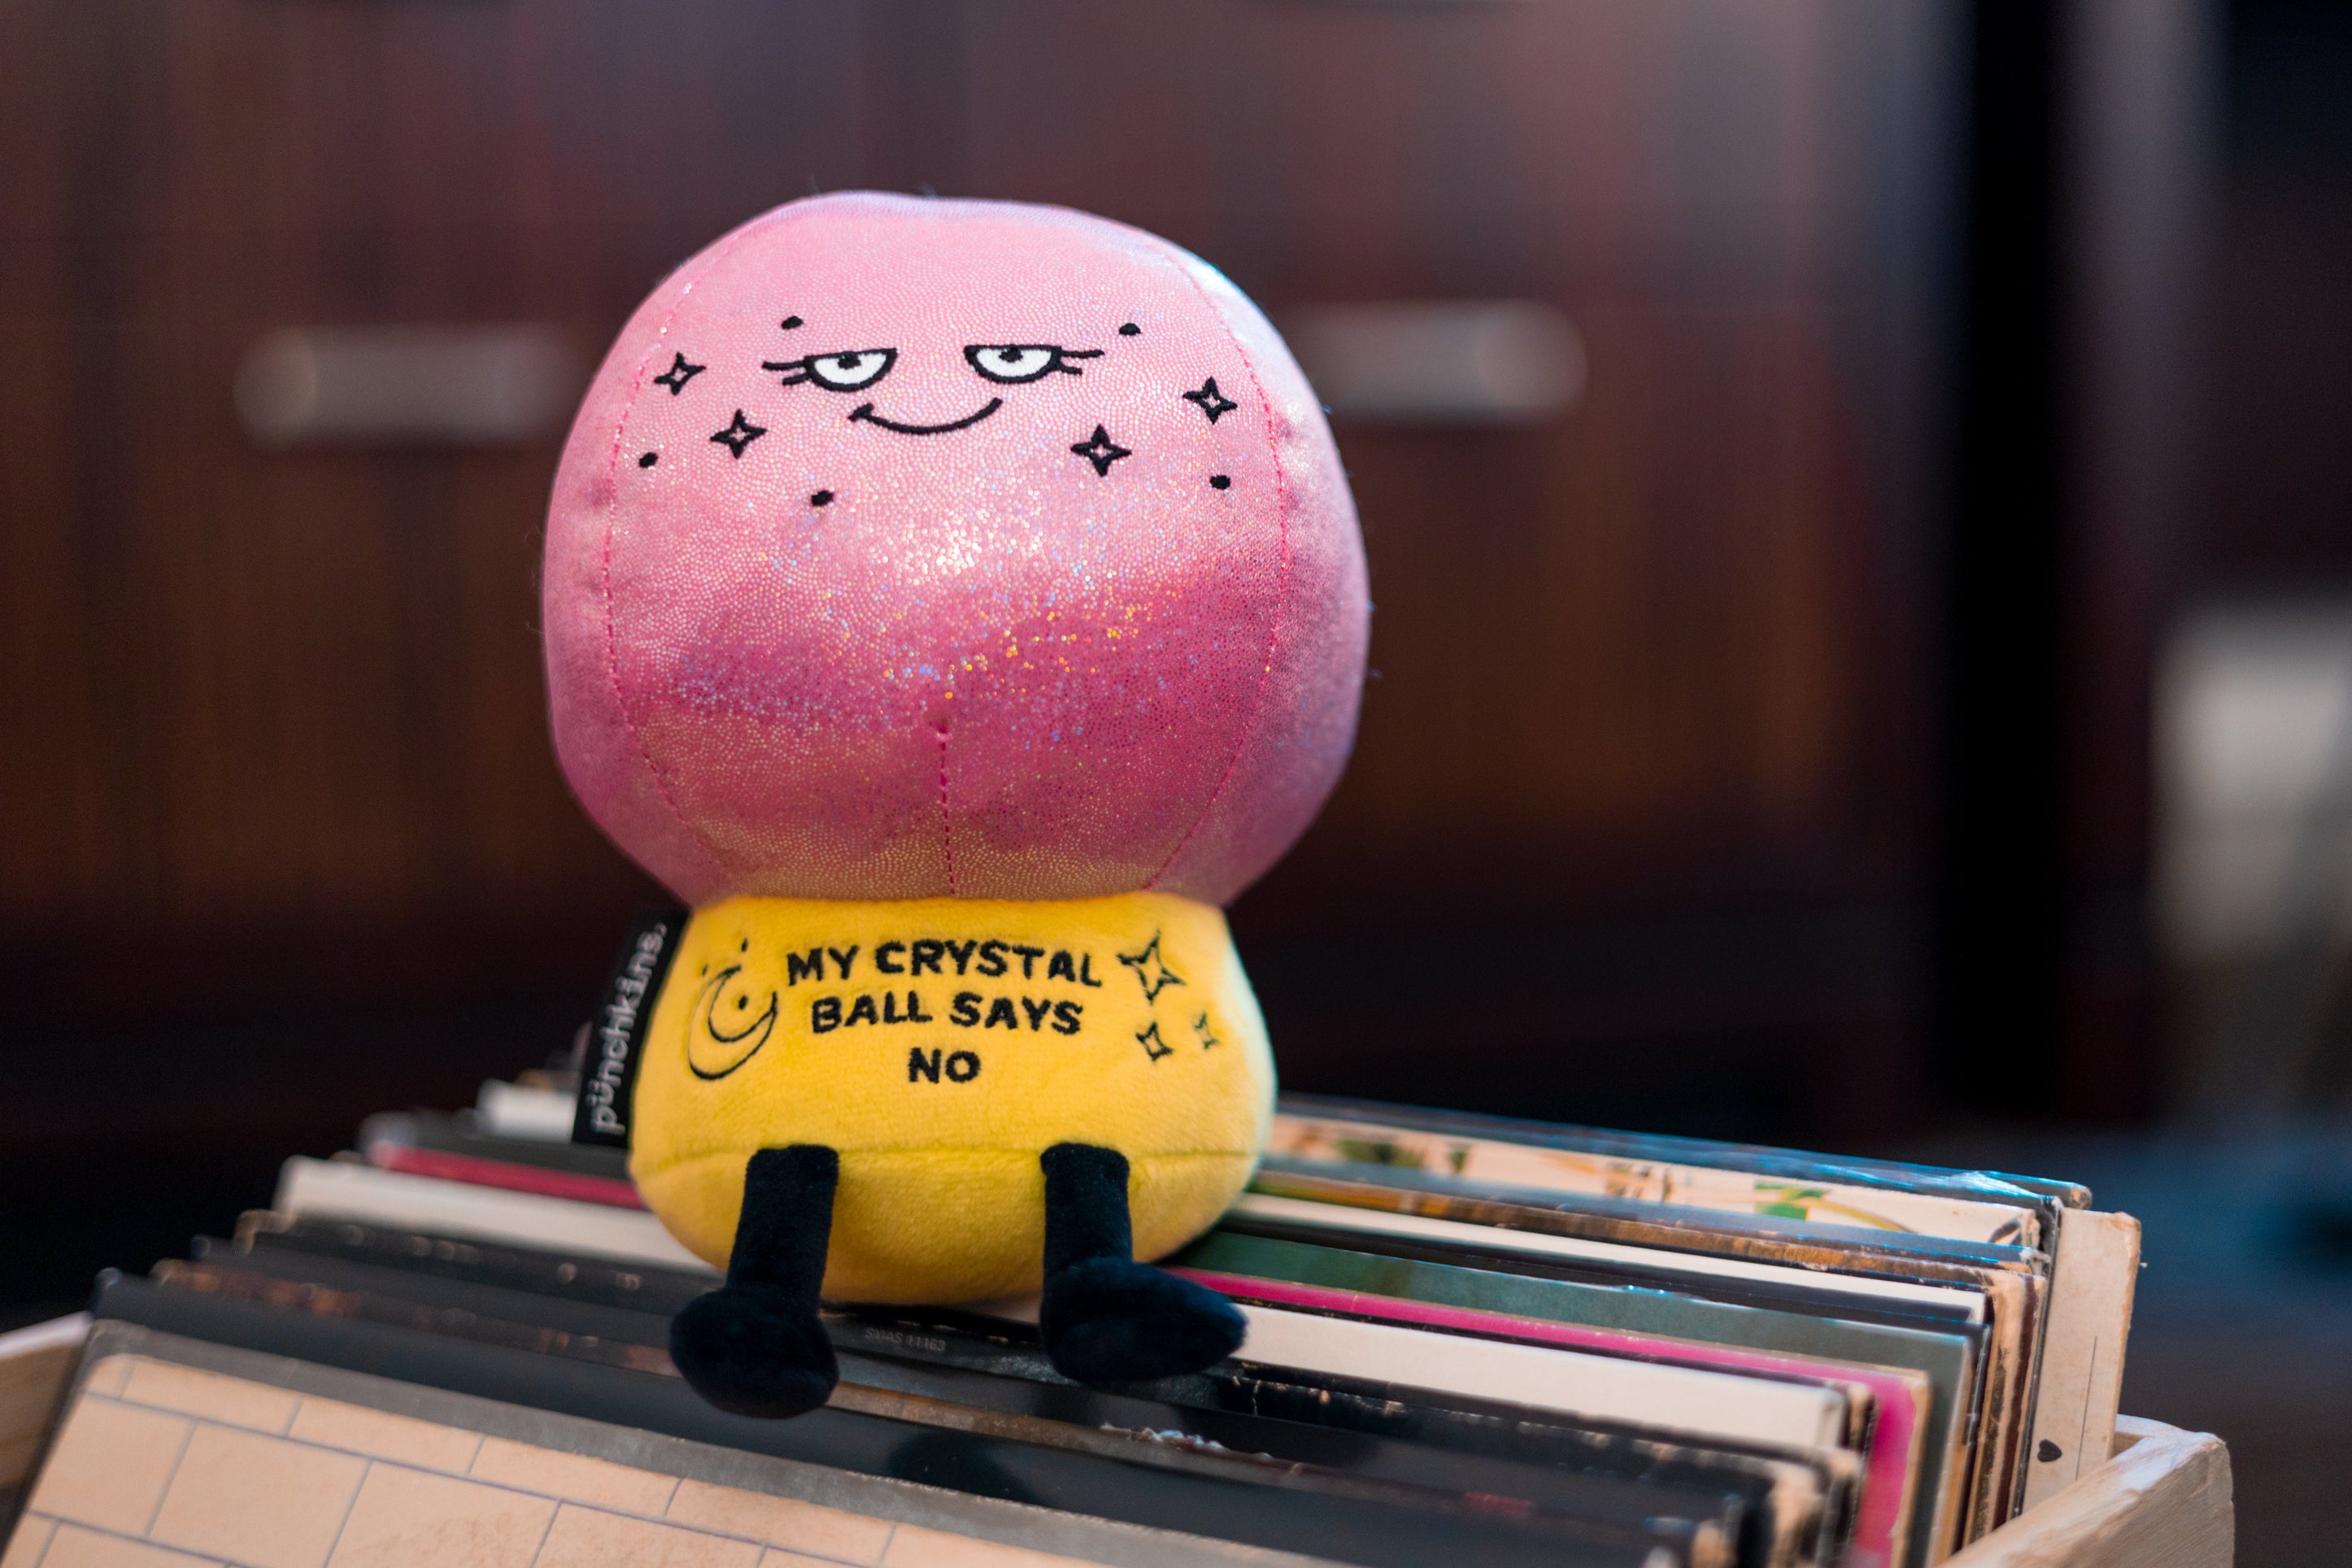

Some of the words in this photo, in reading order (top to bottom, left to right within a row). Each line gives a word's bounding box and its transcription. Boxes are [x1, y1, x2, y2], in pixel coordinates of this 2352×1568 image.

[787, 943, 859, 986] MY
[875, 939, 1102, 987] CRYSTAL
[812, 991, 933, 1034] BALL
[950, 992, 1082, 1034] SAYS
[908, 1047, 981, 1083] NO
